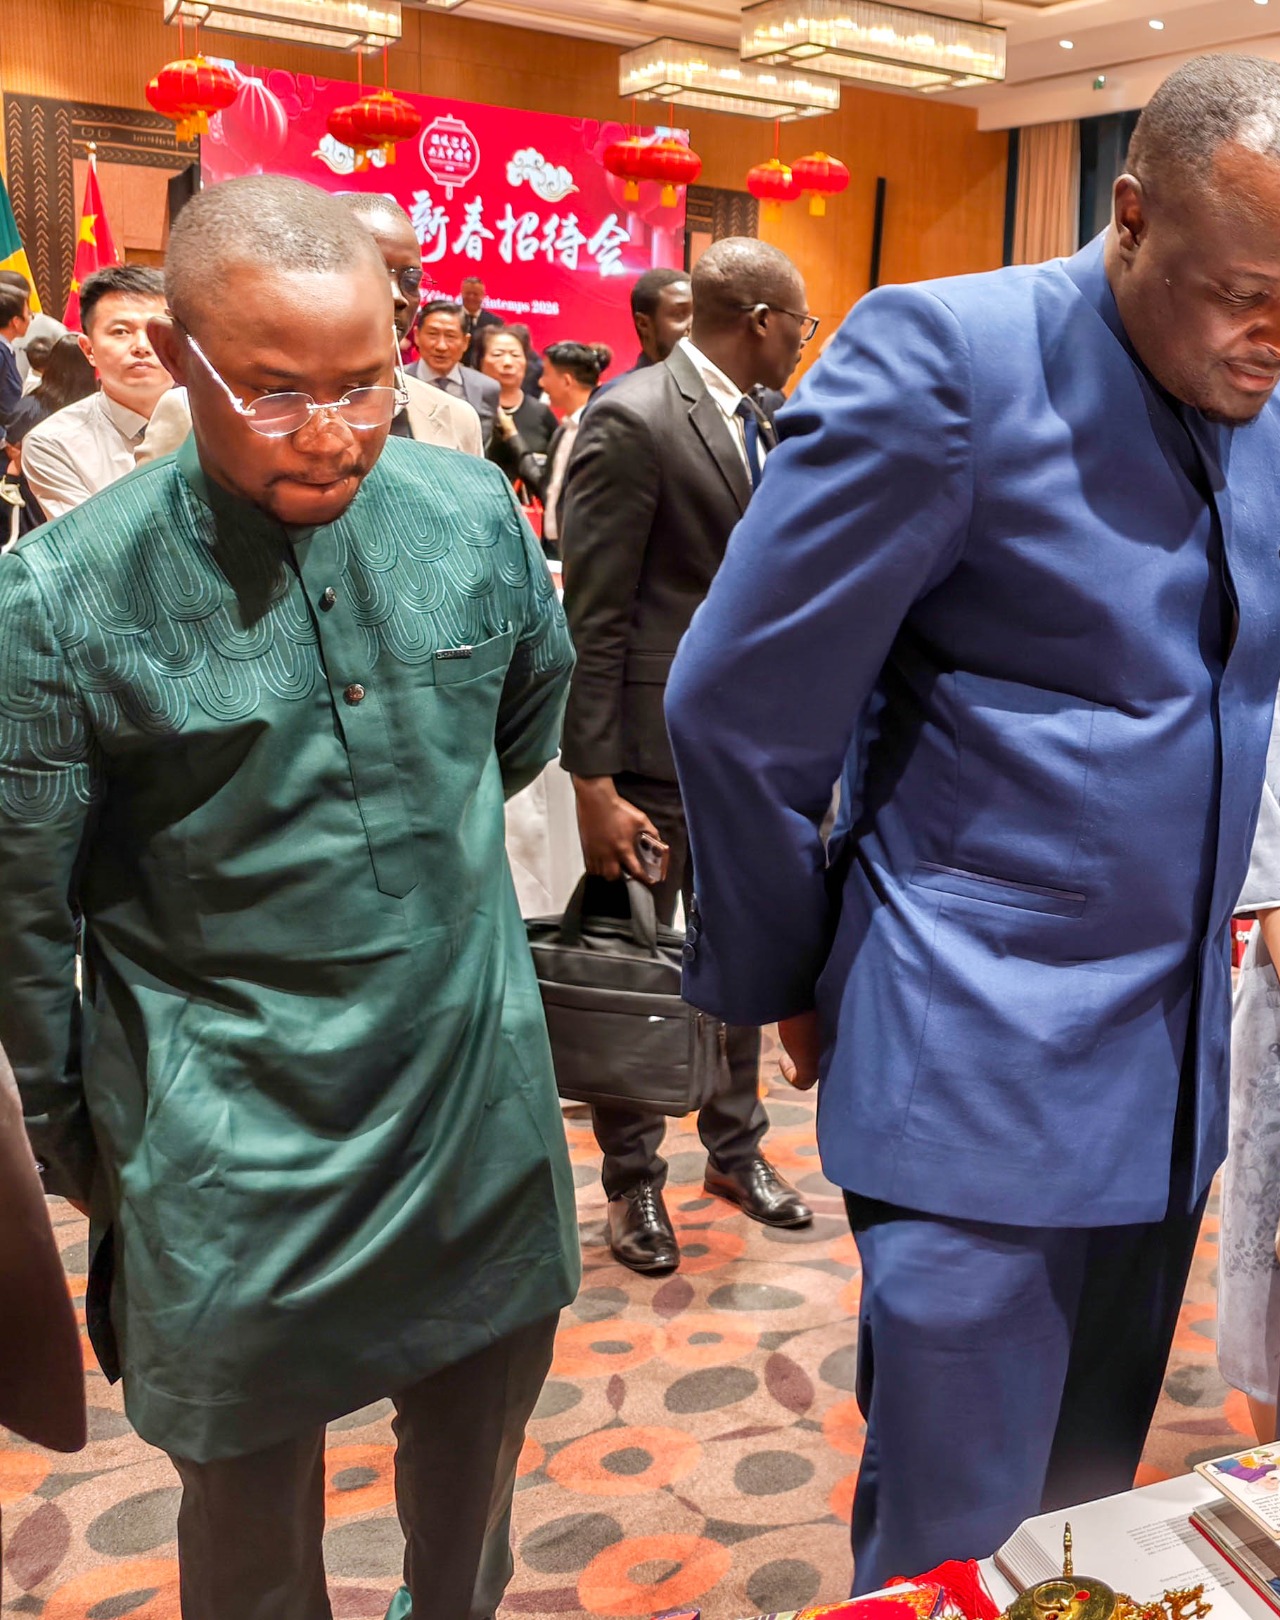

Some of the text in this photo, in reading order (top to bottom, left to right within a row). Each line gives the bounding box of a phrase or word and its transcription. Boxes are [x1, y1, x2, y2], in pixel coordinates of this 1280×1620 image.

[408, 189, 631, 277] 新春招待会
[481, 295, 531, 314] rintemps
[531, 299, 560, 315] 2026
